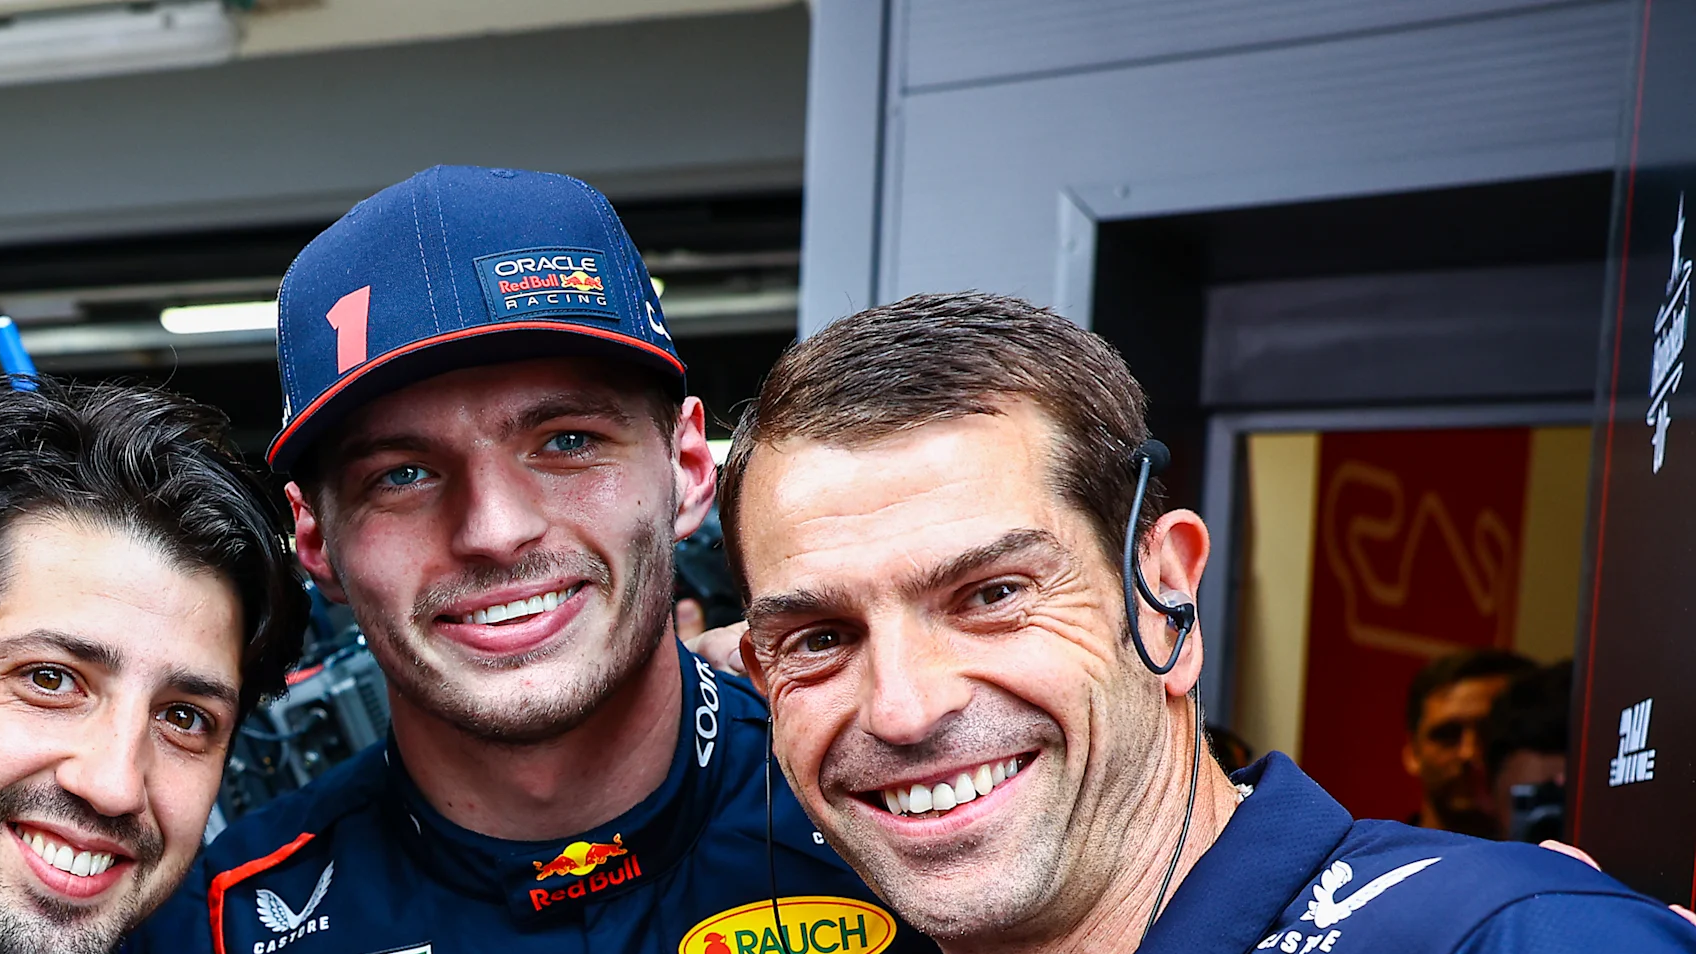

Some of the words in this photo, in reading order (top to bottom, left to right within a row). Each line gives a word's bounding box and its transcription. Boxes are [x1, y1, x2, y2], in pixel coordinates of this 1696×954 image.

[494, 256, 598, 277] ORACLE
[498, 275, 530, 294] Red
[530, 273, 559, 290] Bull
[504, 293, 608, 311] RACING
[325, 285, 371, 375] 1
[529, 879, 586, 912] Red
[588, 855, 642, 895] Bull
